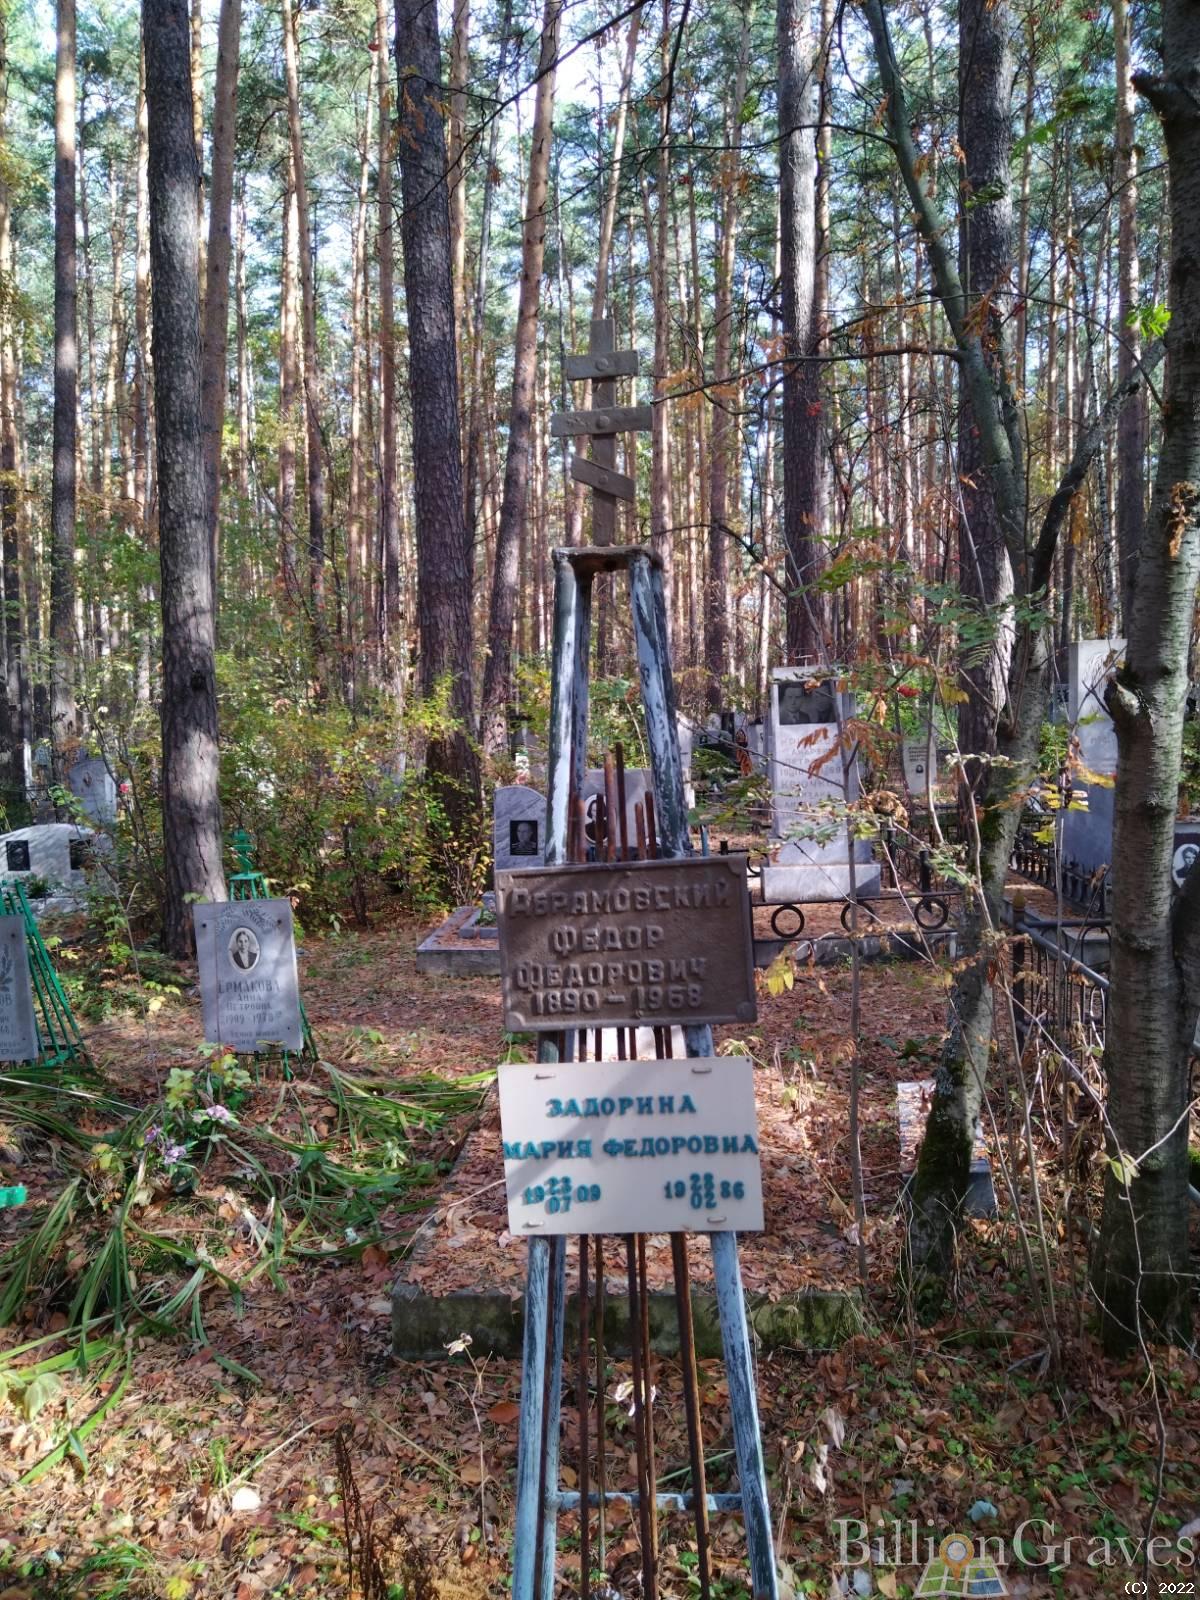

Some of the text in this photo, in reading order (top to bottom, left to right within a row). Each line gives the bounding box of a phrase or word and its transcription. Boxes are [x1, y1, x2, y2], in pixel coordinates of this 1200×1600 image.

[553, 925, 664, 957] ФЕДОР
[516, 958, 707, 992] ФЕДОРОВИЧ
[547, 1095, 696, 1118] ЗАДОРИНА
[503, 1134, 758, 1160] МАРИЯ ФЕДОРОВНА
